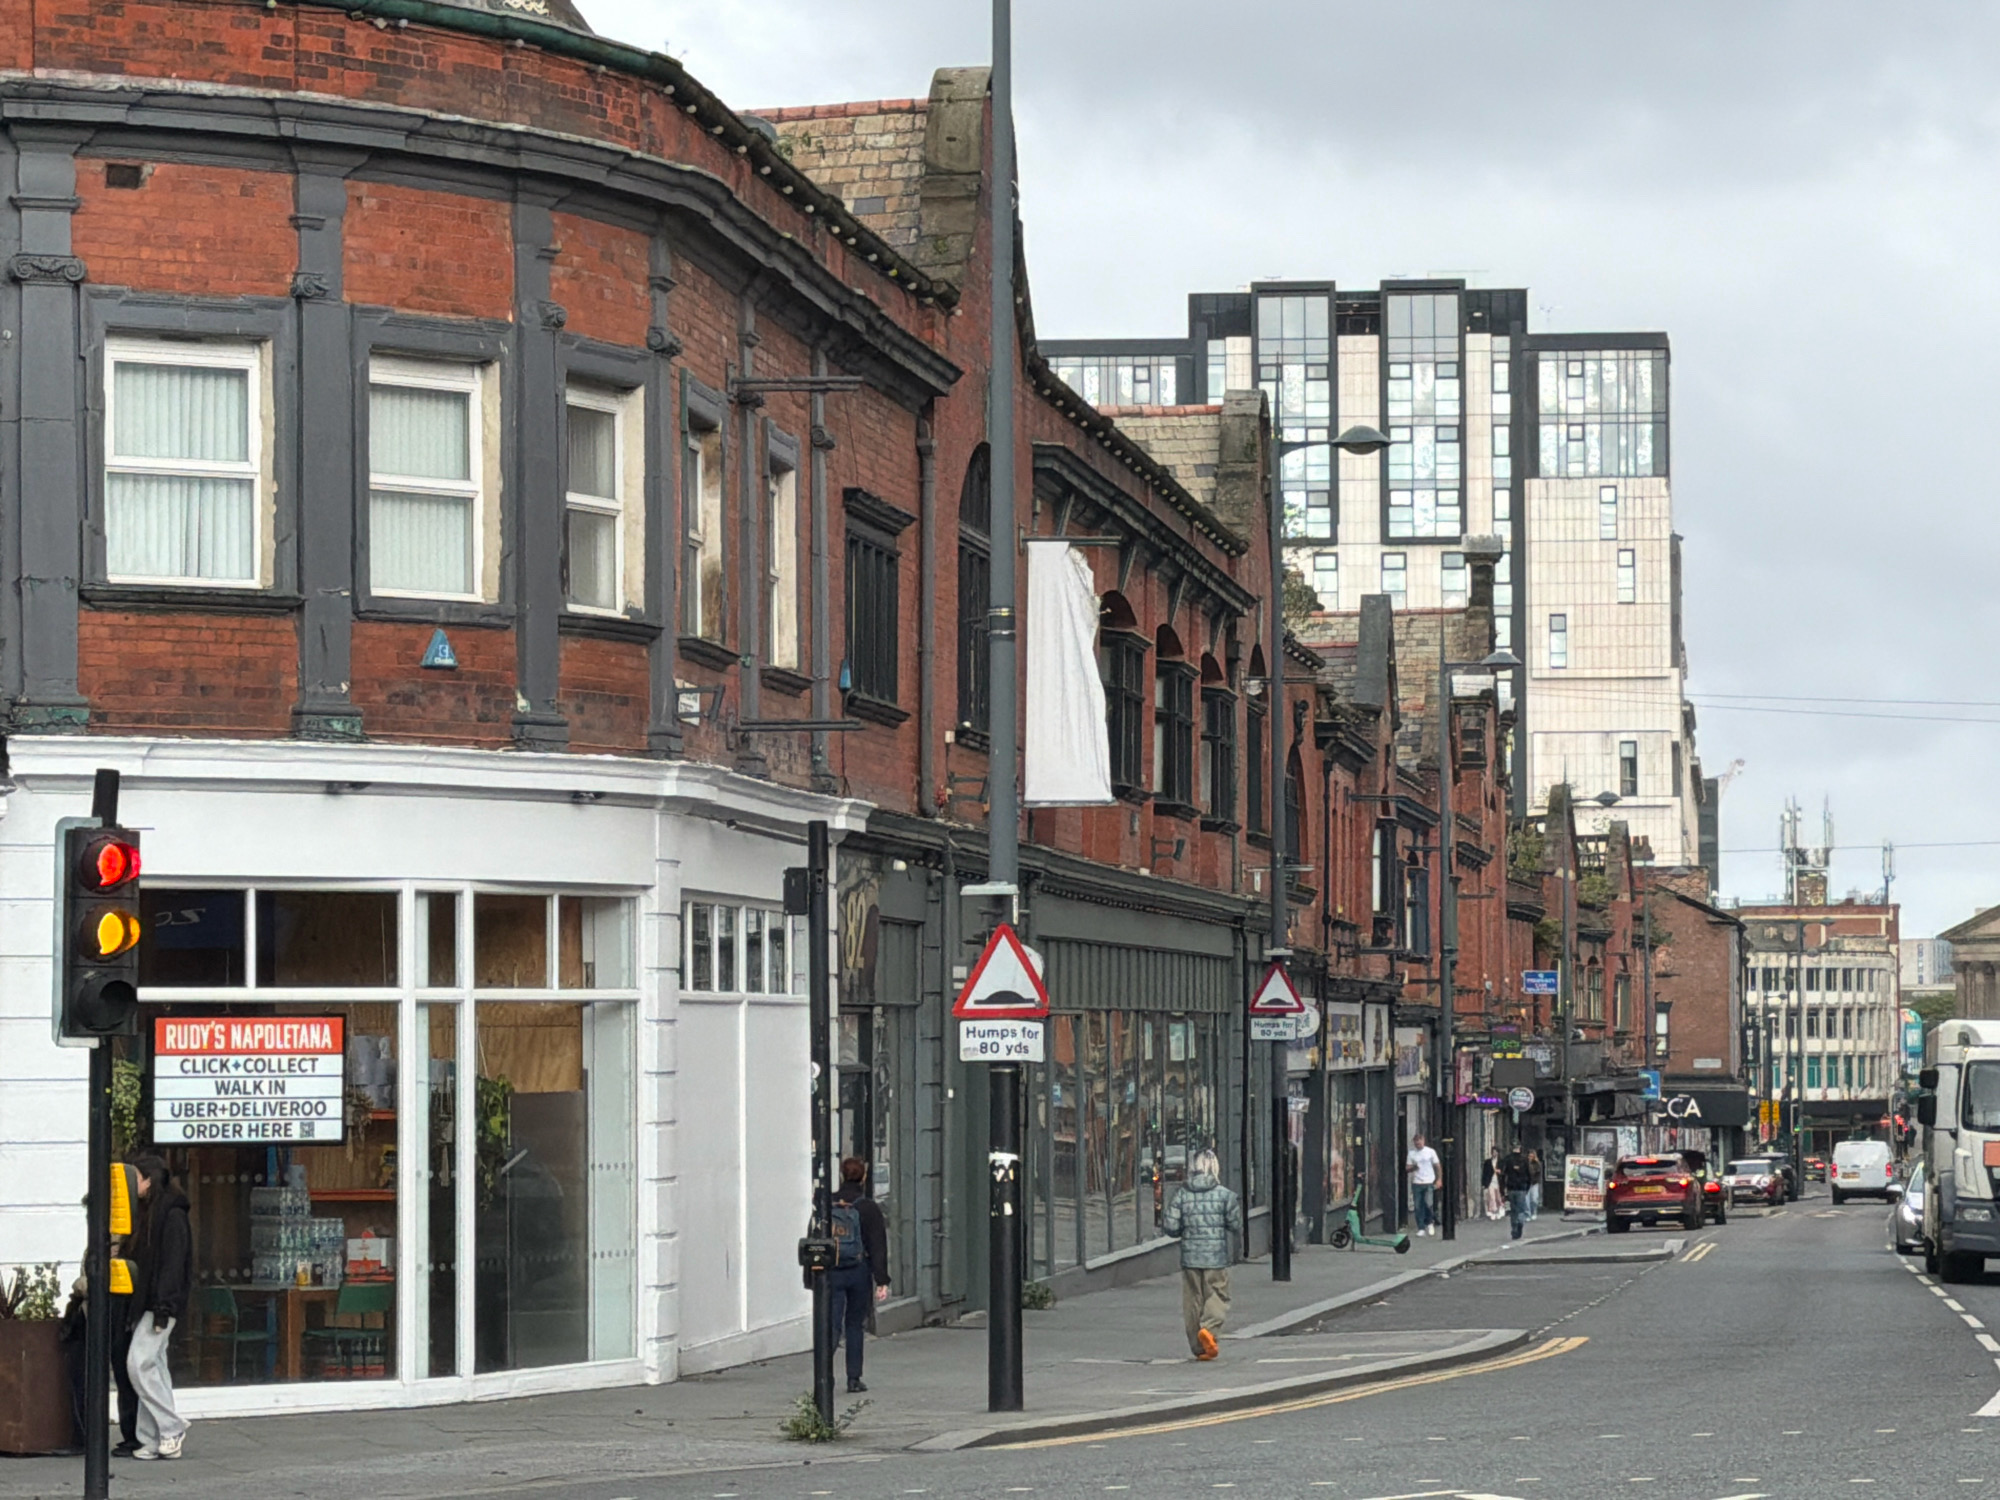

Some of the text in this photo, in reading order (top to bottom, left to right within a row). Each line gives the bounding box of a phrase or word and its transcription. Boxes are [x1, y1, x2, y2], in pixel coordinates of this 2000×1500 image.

[845, 890, 866, 969] 82
[966, 1026, 1039, 1040] Humps for
[1253, 1020, 1280, 1029] Humps
[1282, 1020, 1294, 1029] for
[1273, 1029, 1287, 1037] yds
[165, 1020, 333, 1050] RUDY'S NAPOLETANA
[979, 1041, 1029, 1056] 80 yds
[214, 1079, 286, 1096] WALK IN
[170, 1101, 327, 1118] UBER+DELIVEROO
[182, 1122, 293, 1139] ORDER HERE
